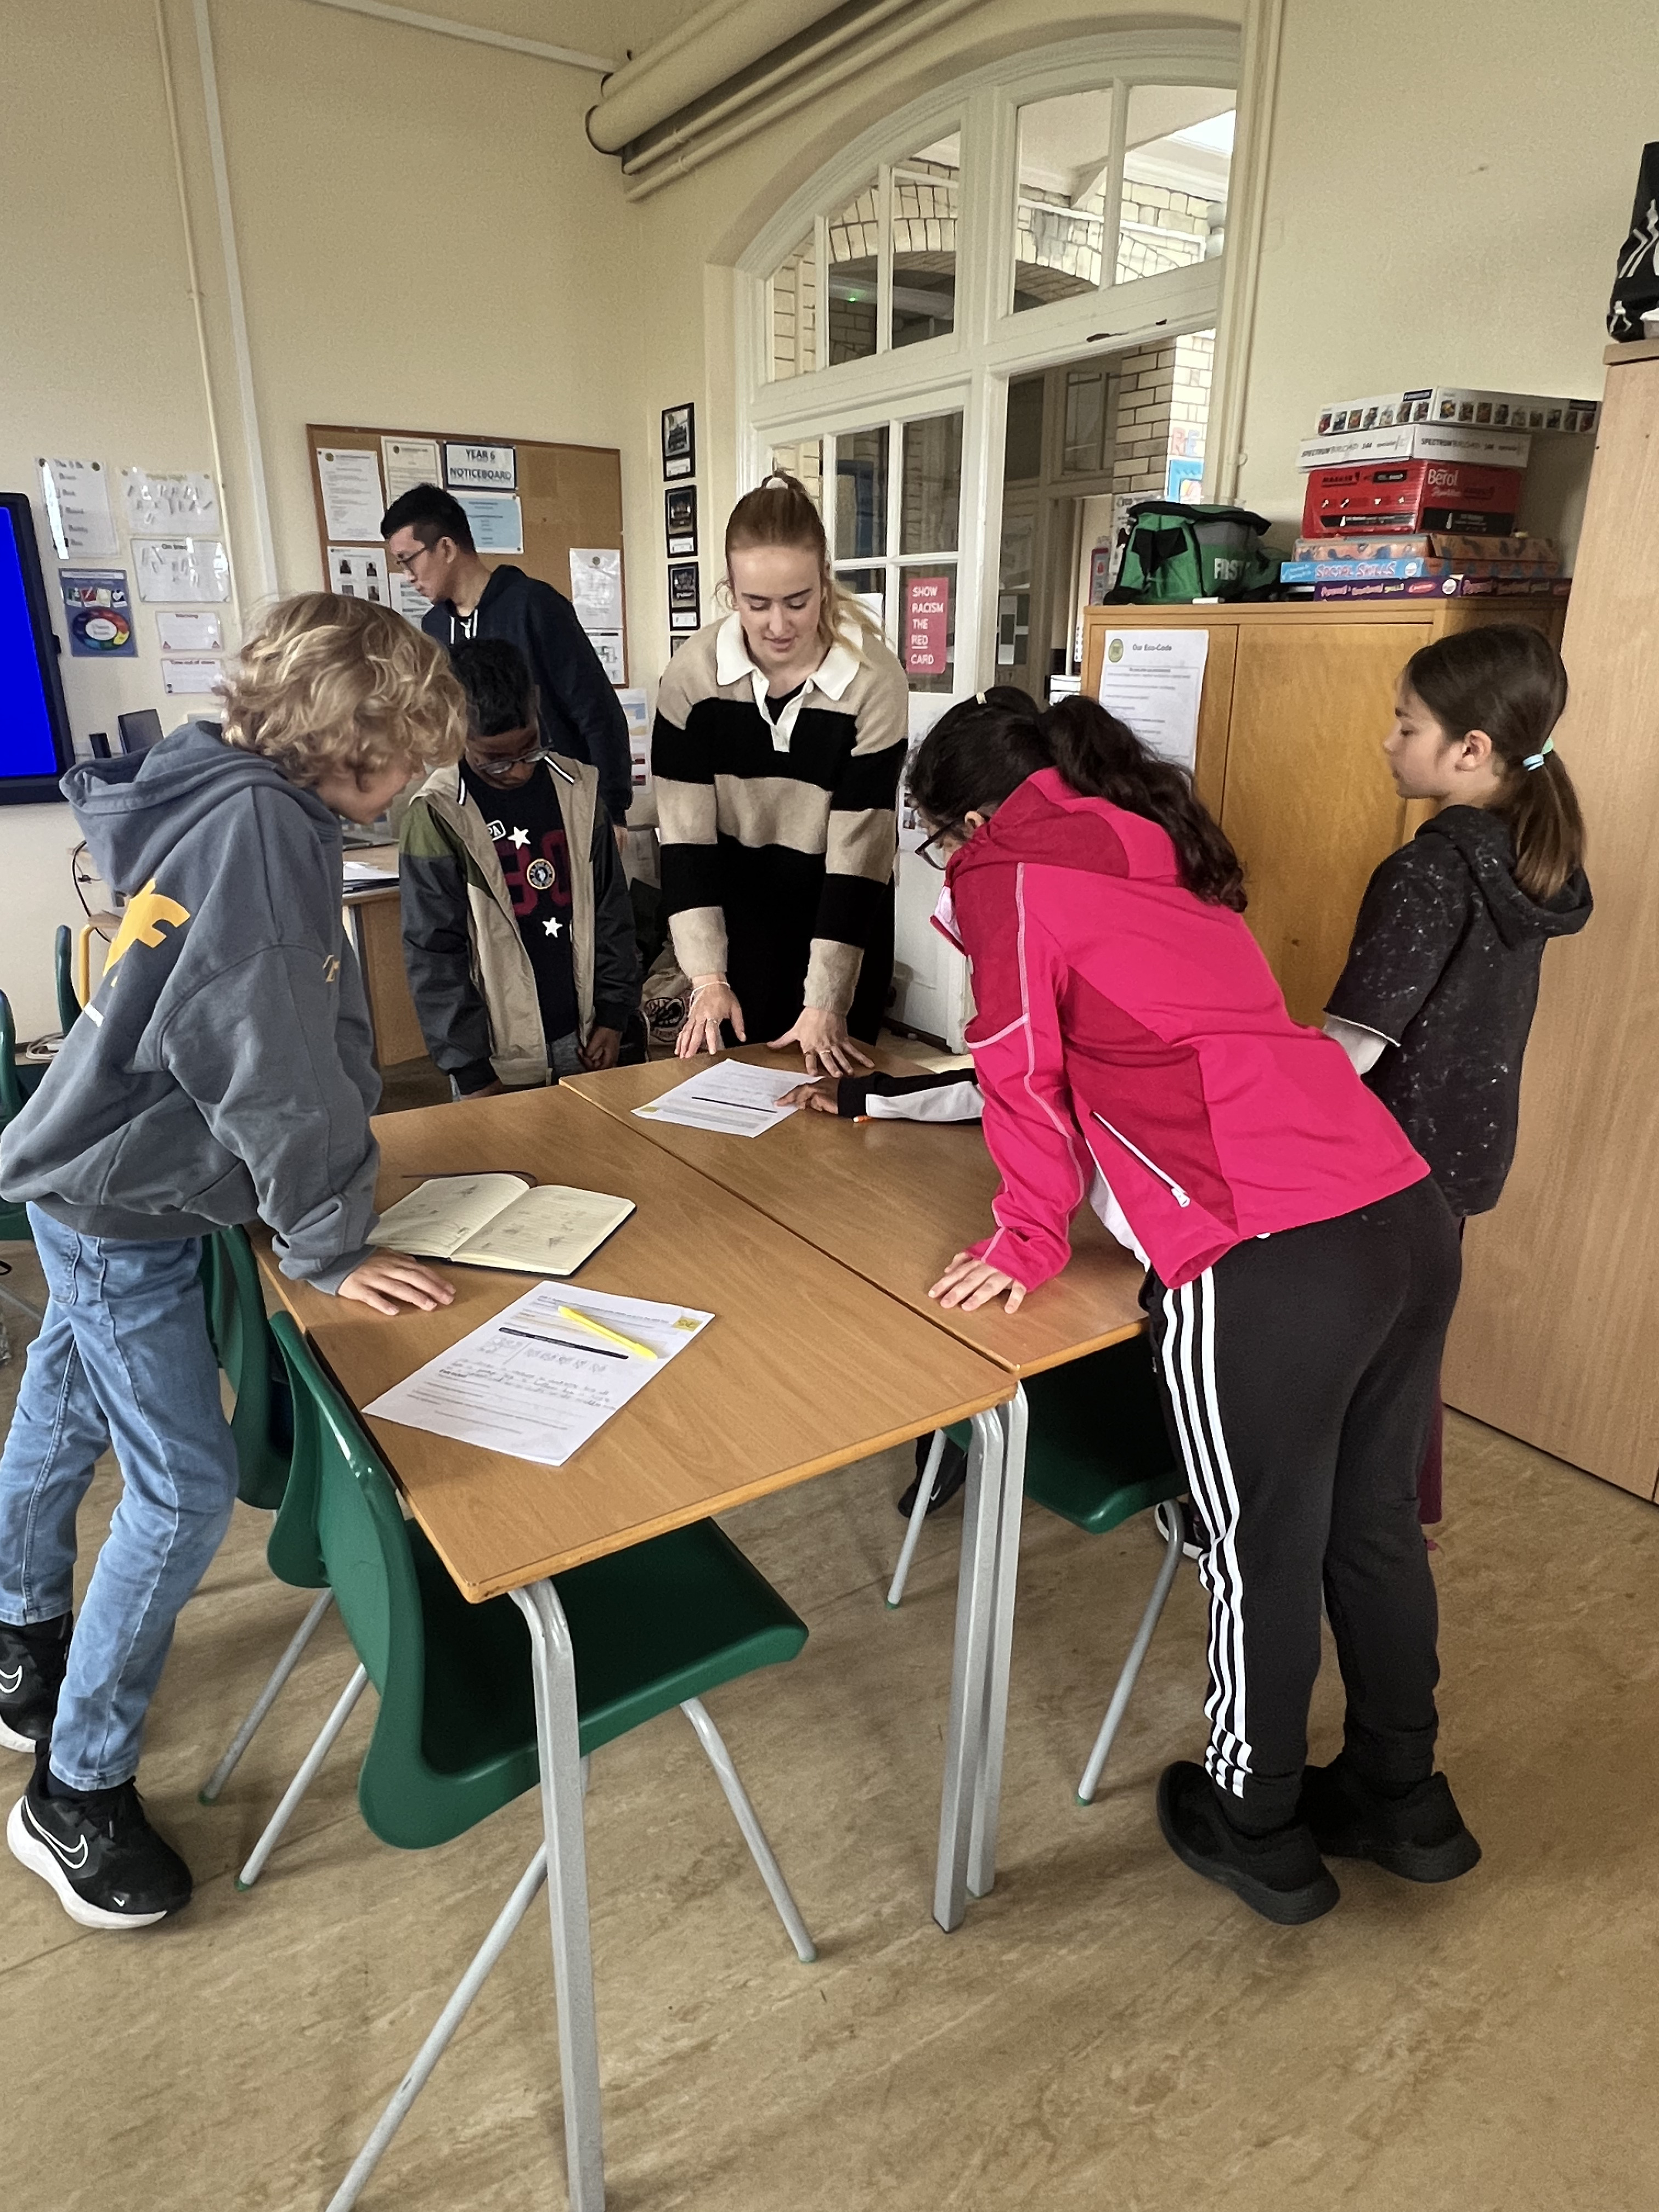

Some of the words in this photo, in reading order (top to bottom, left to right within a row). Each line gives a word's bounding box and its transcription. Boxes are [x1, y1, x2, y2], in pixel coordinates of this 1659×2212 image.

[465, 449, 488, 461] YEAR
[490, 450, 496, 460] 6
[450, 467, 511, 481] NOTICEBOARD
[912, 586, 938, 597] SHOW
[912, 602, 944, 613] RACISM
[912, 618, 928, 630] THE
[911, 634, 928, 645] RED
[911, 654, 934, 665] CARD
